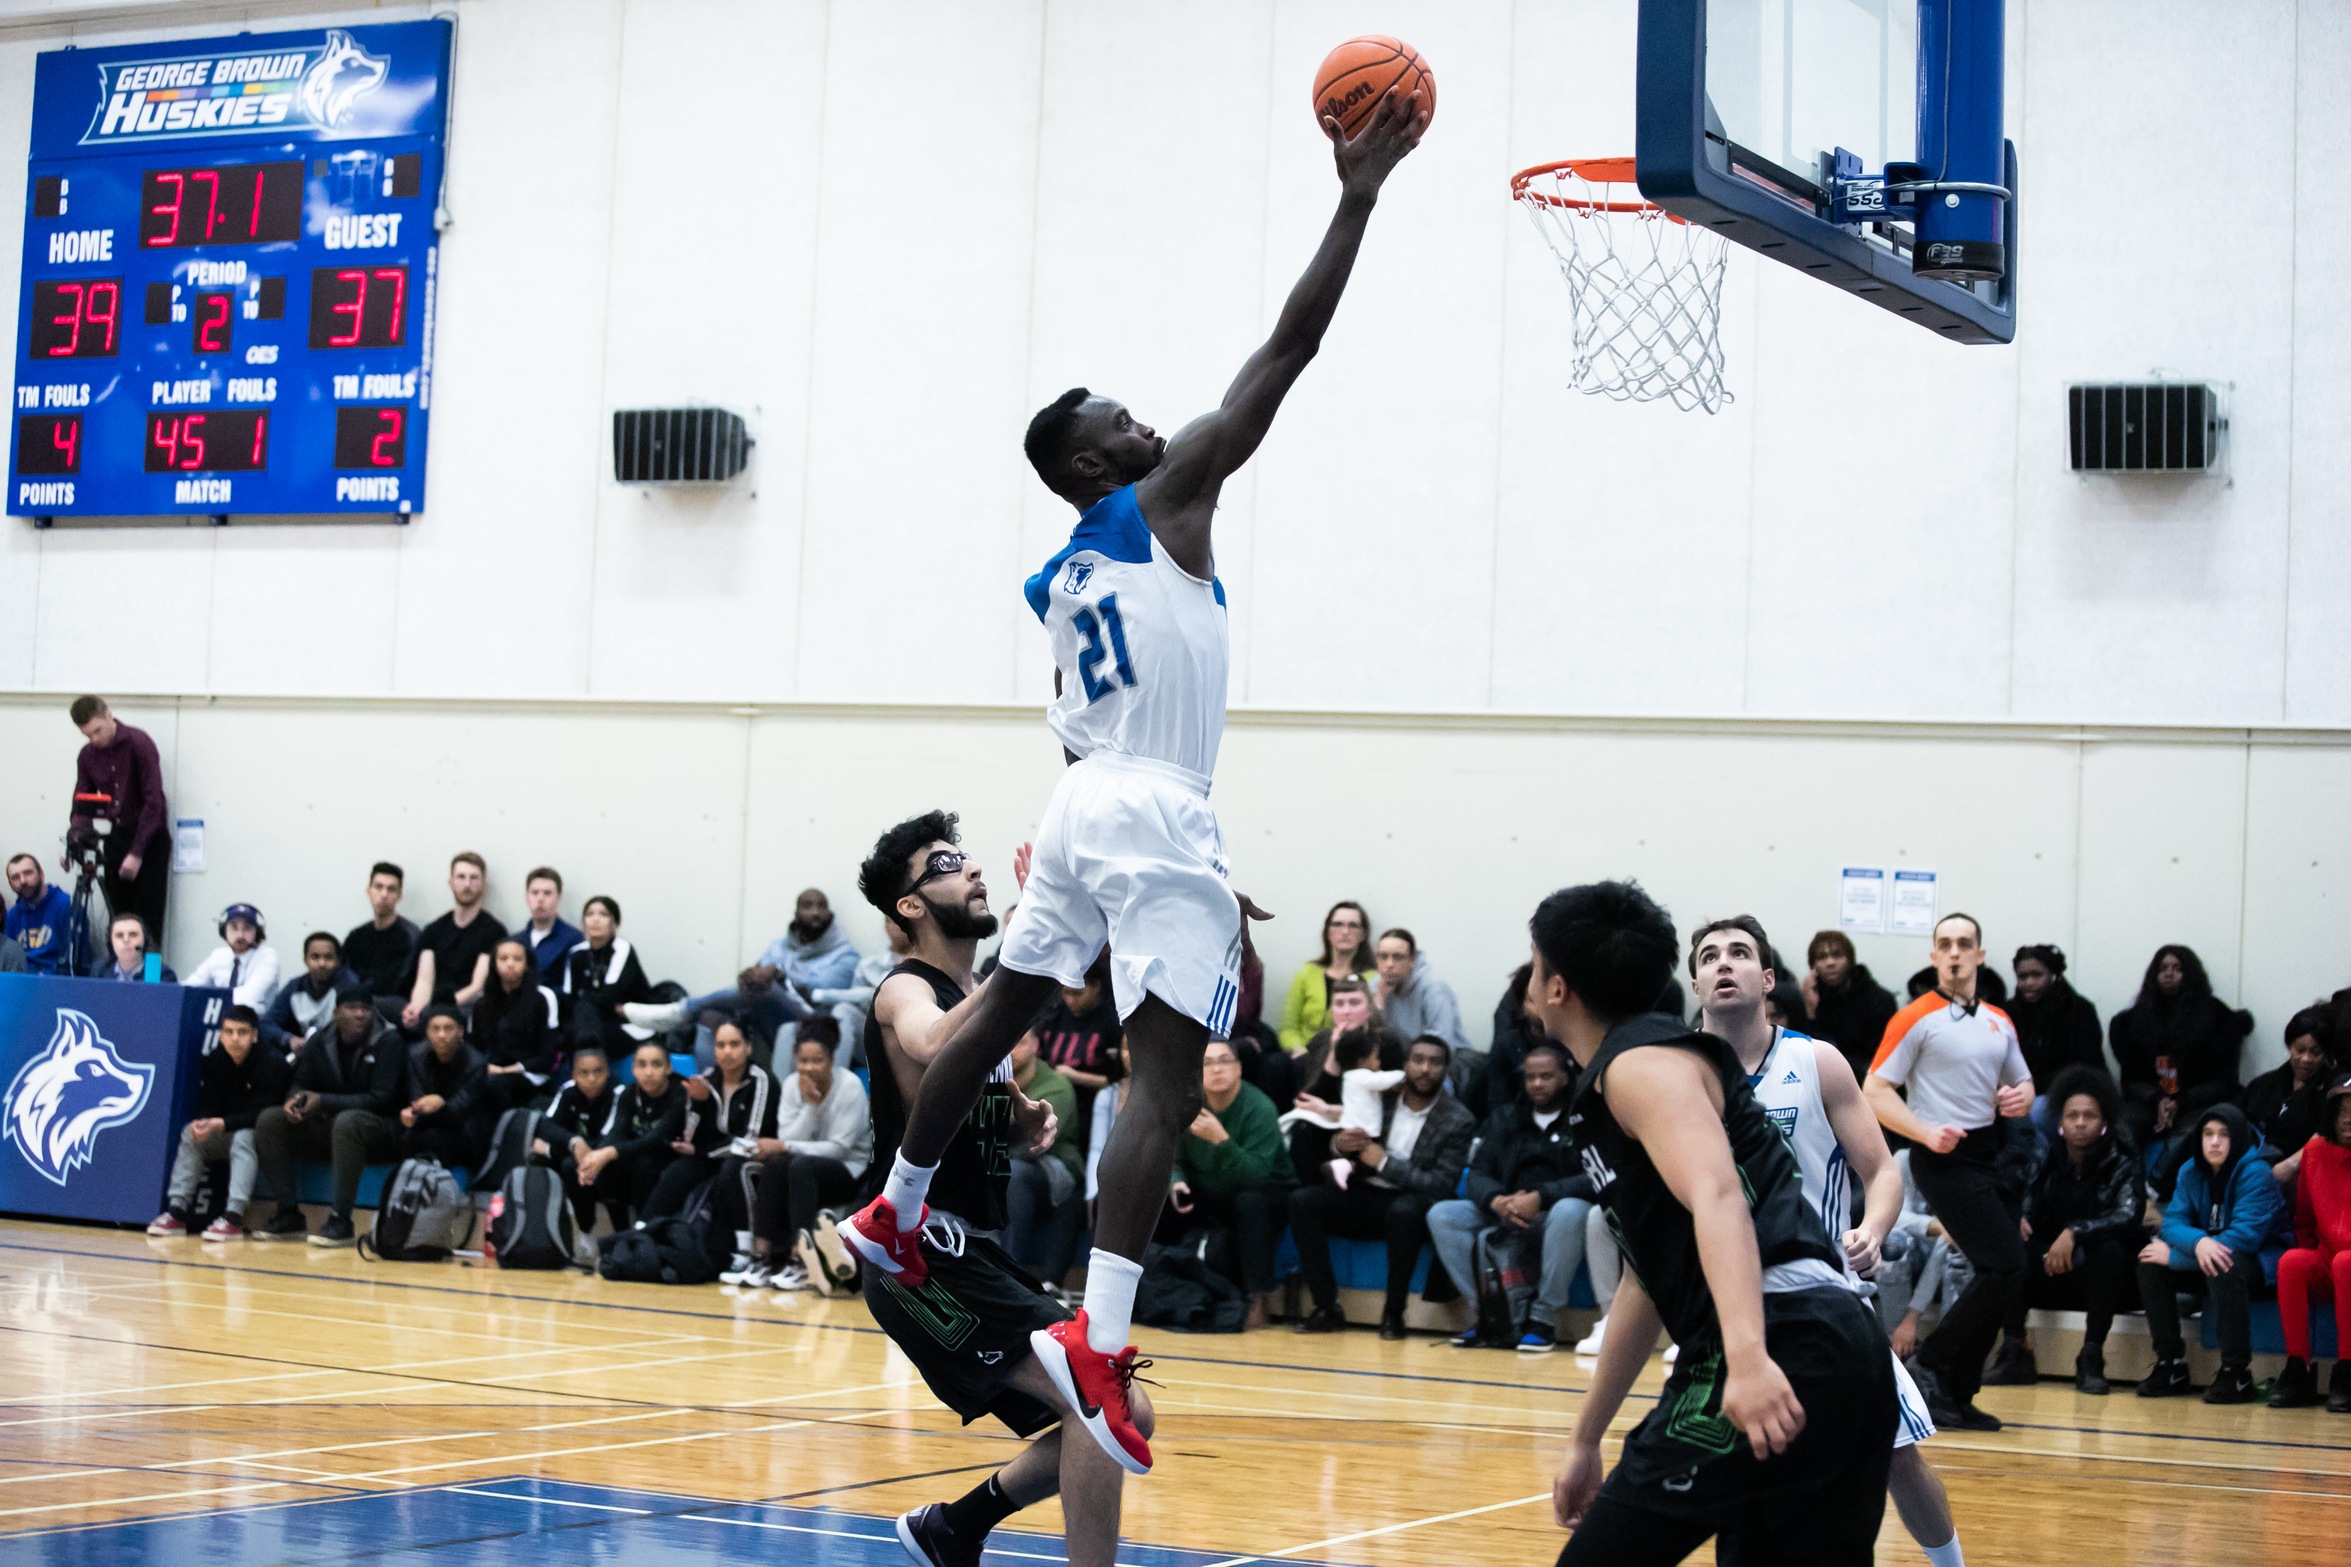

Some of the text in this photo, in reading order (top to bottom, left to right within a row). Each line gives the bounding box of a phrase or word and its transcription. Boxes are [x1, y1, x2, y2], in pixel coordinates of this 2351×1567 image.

[115, 53, 307, 92] GEORGE BROWN
[100, 91, 292, 134] HUSKIES
[147, 170, 264, 246] 37.1
[48, 229, 114, 264] HOME
[324, 212, 402, 250] GUEST
[187, 261, 247, 286] PERIOD
[172, 285, 182, 303] P
[328, 268, 406, 347] 37
[48, 282, 119, 356] 39
[200, 296, 229, 351] 2
[18, 383, 91, 408] TM FOULS
[152, 377, 277, 404] PLAYER FOULS
[333, 374, 415, 399] TM FOULS
[53, 421, 78, 467] 4
[153, 414, 265, 470] 45 1
[370, 409, 402, 466] 2
[19, 482, 75, 506] POINTS
[175, 479, 232, 504] MATCH
[336, 476, 400, 502] POINTS
[1070, 591, 1139, 706] 21
